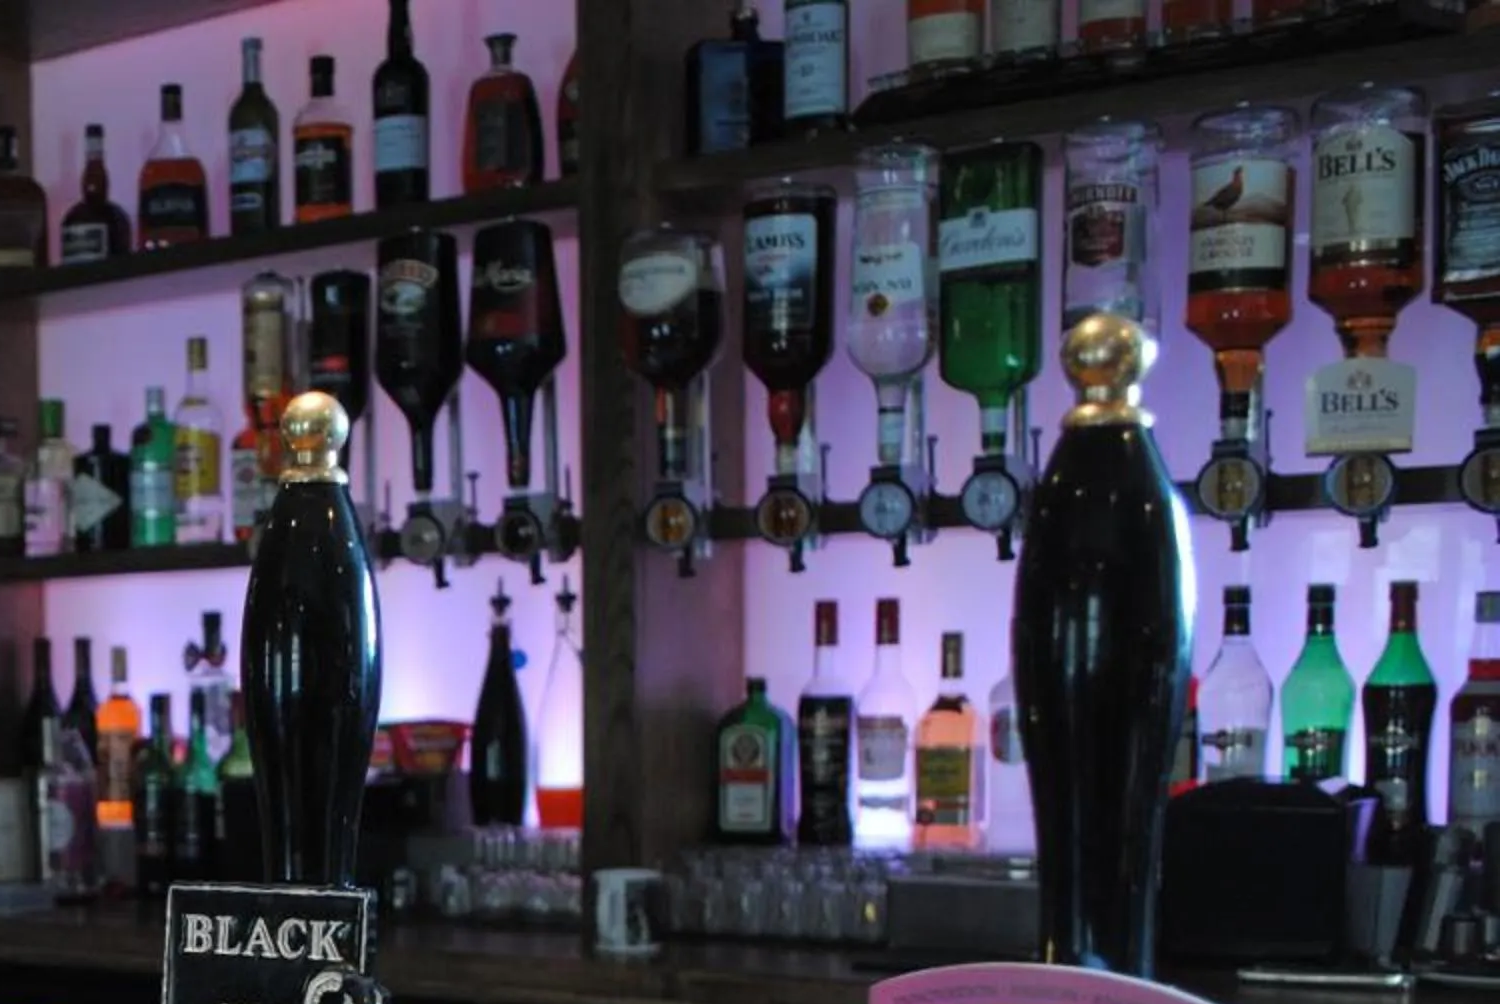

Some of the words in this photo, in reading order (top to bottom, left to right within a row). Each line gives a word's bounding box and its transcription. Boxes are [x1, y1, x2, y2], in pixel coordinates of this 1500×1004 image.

[1317, 147, 1398, 181] BELL'S
[1320, 388, 1400, 416] BELL'S
[182, 913, 346, 962] BLACK
